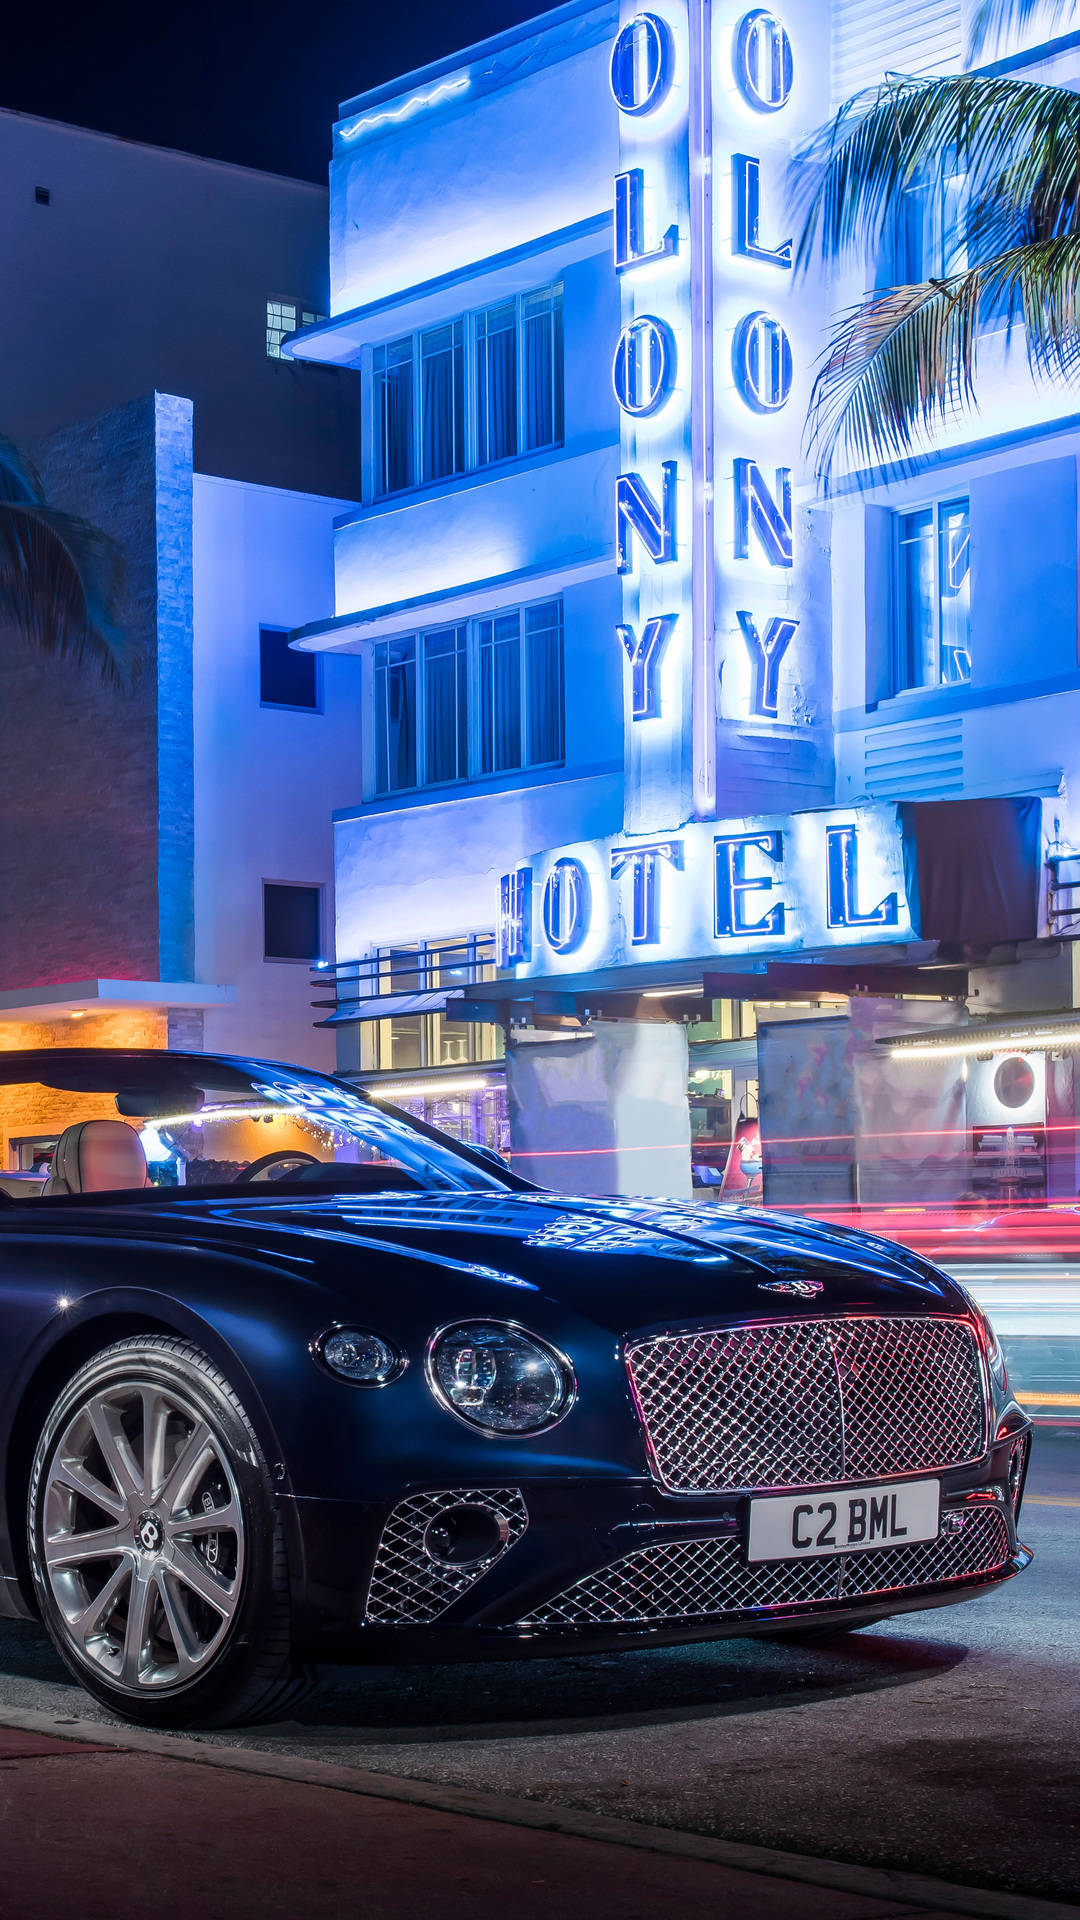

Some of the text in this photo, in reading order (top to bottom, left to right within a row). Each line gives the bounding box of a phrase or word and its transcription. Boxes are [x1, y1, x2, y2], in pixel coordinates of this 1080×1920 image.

[496, 824, 898, 968] HOTEL
[792, 1494, 908, 1549] C2 BML
